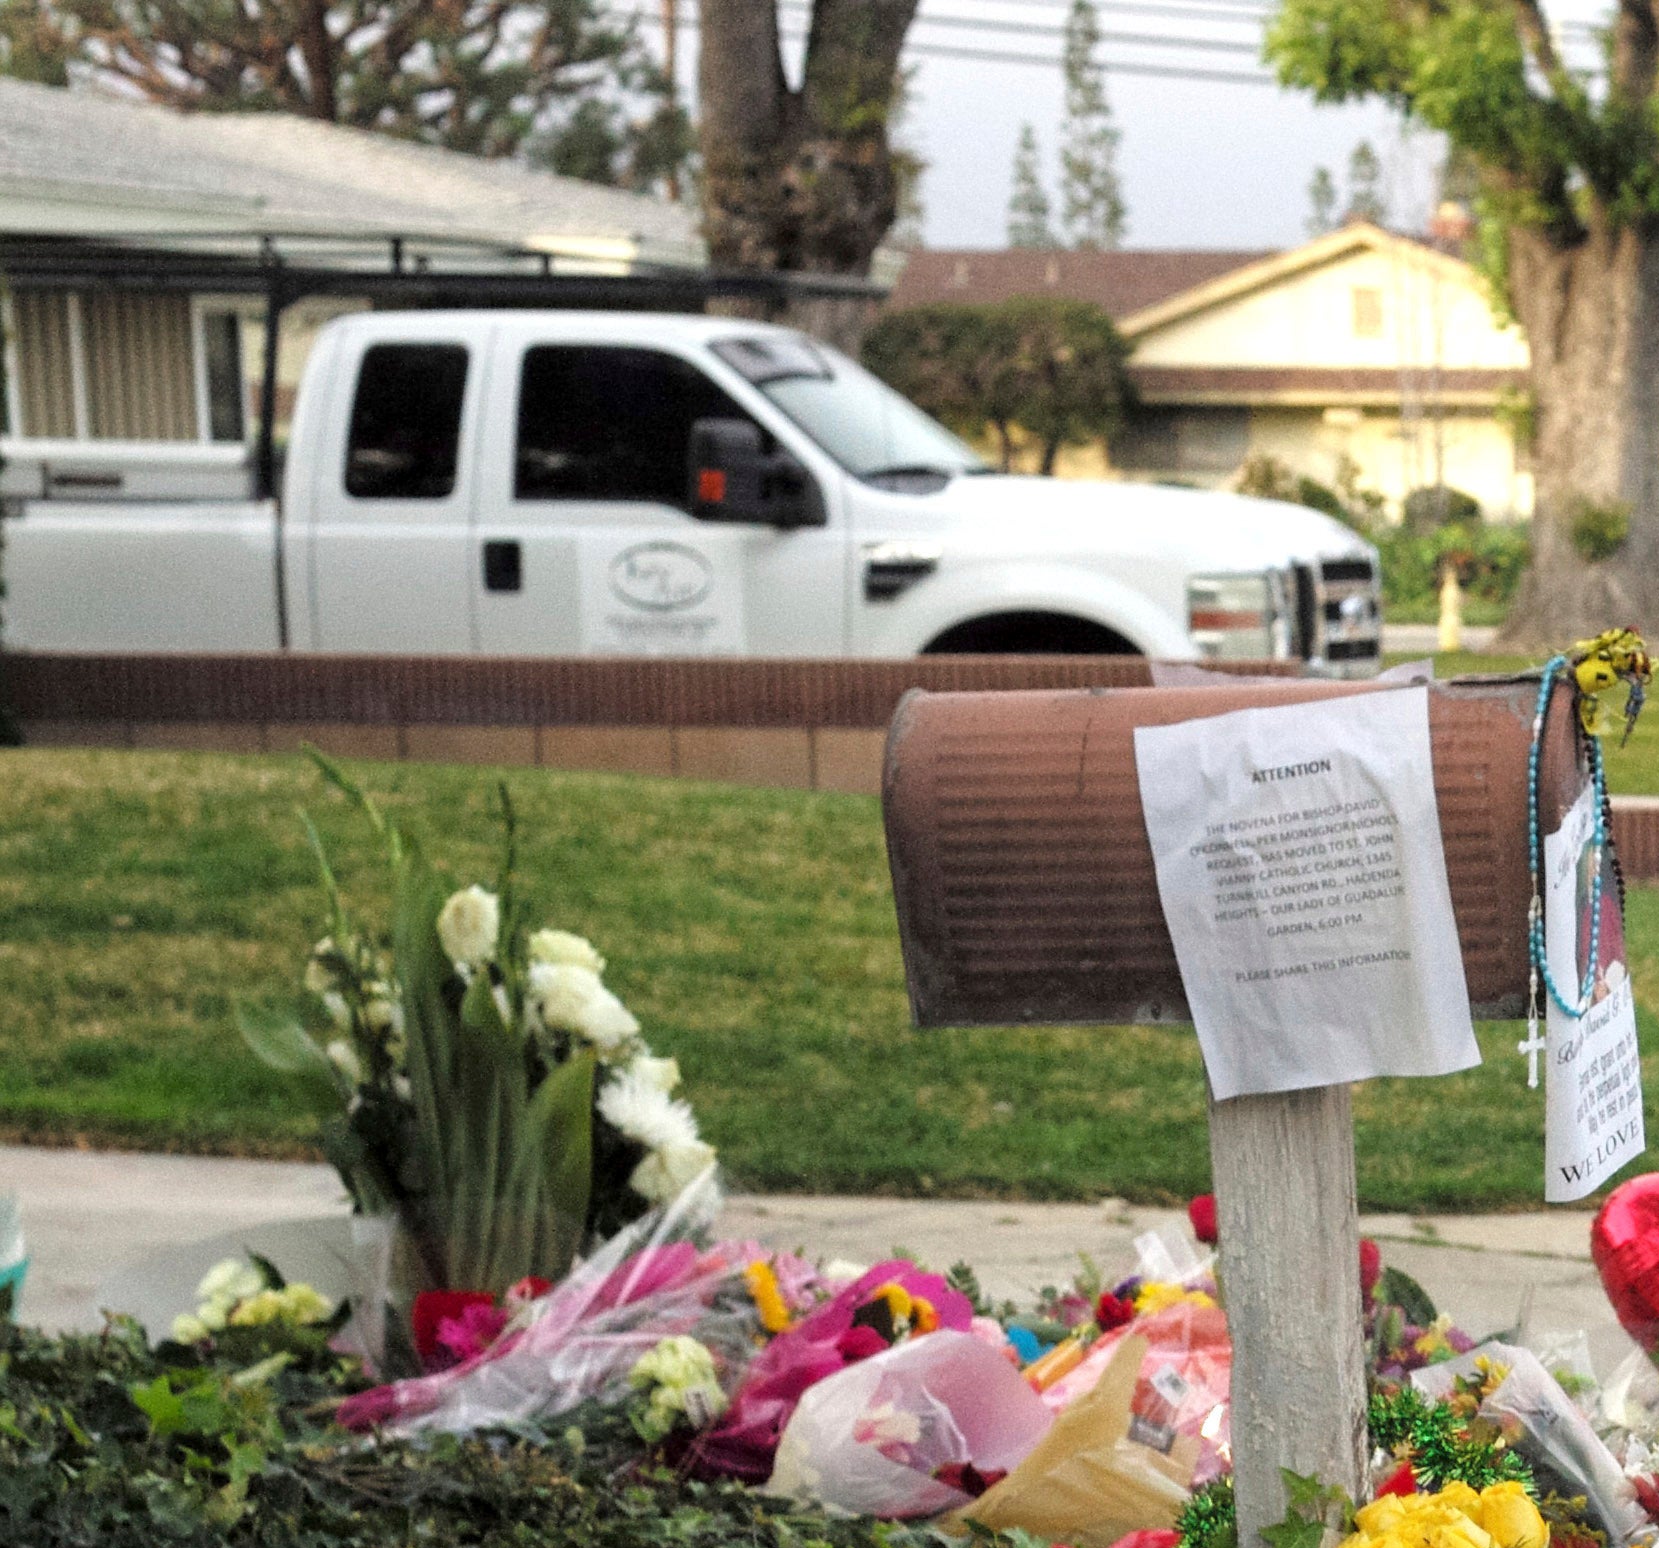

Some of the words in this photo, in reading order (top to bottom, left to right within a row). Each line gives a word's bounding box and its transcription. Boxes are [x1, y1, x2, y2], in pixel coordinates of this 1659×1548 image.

[1252, 759, 1332, 783] ATTENTION
[1229, 817, 1276, 832] NOVENA
[1278, 812, 1299, 825] FOR
[1302, 805, 1343, 820] BISHOP
[1344, 799, 1380, 814] DAVID
[1257, 835, 1277, 847] PER
[1280, 822, 1350, 844] MONSIGNOR
[1285, 844, 1326, 859] MOVED
[1329, 840, 1345, 852] TO
[1365, 833, 1394, 847] JOHN
[1259, 863, 1312, 881] CATHOLIC
[1272, 881, 1319, 896] CANYON
[1346, 869, 1401, 886] HACIENDA
[1214, 907, 1259, 922] HEIGHTS
[1271, 903, 1294, 916] OUR
[1298, 898, 1324, 911] LADY
[1327, 895, 1343, 907] OF
[1345, 913, 1363, 925] PM
[1236, 967, 1271, 983] PLEASE
[1274, 963, 1309, 978] SHARE
[1312, 959, 1336, 972] THIS
[1559, 1154, 1593, 1184] WE
[1597, 1116, 1640, 1166] LOVE
